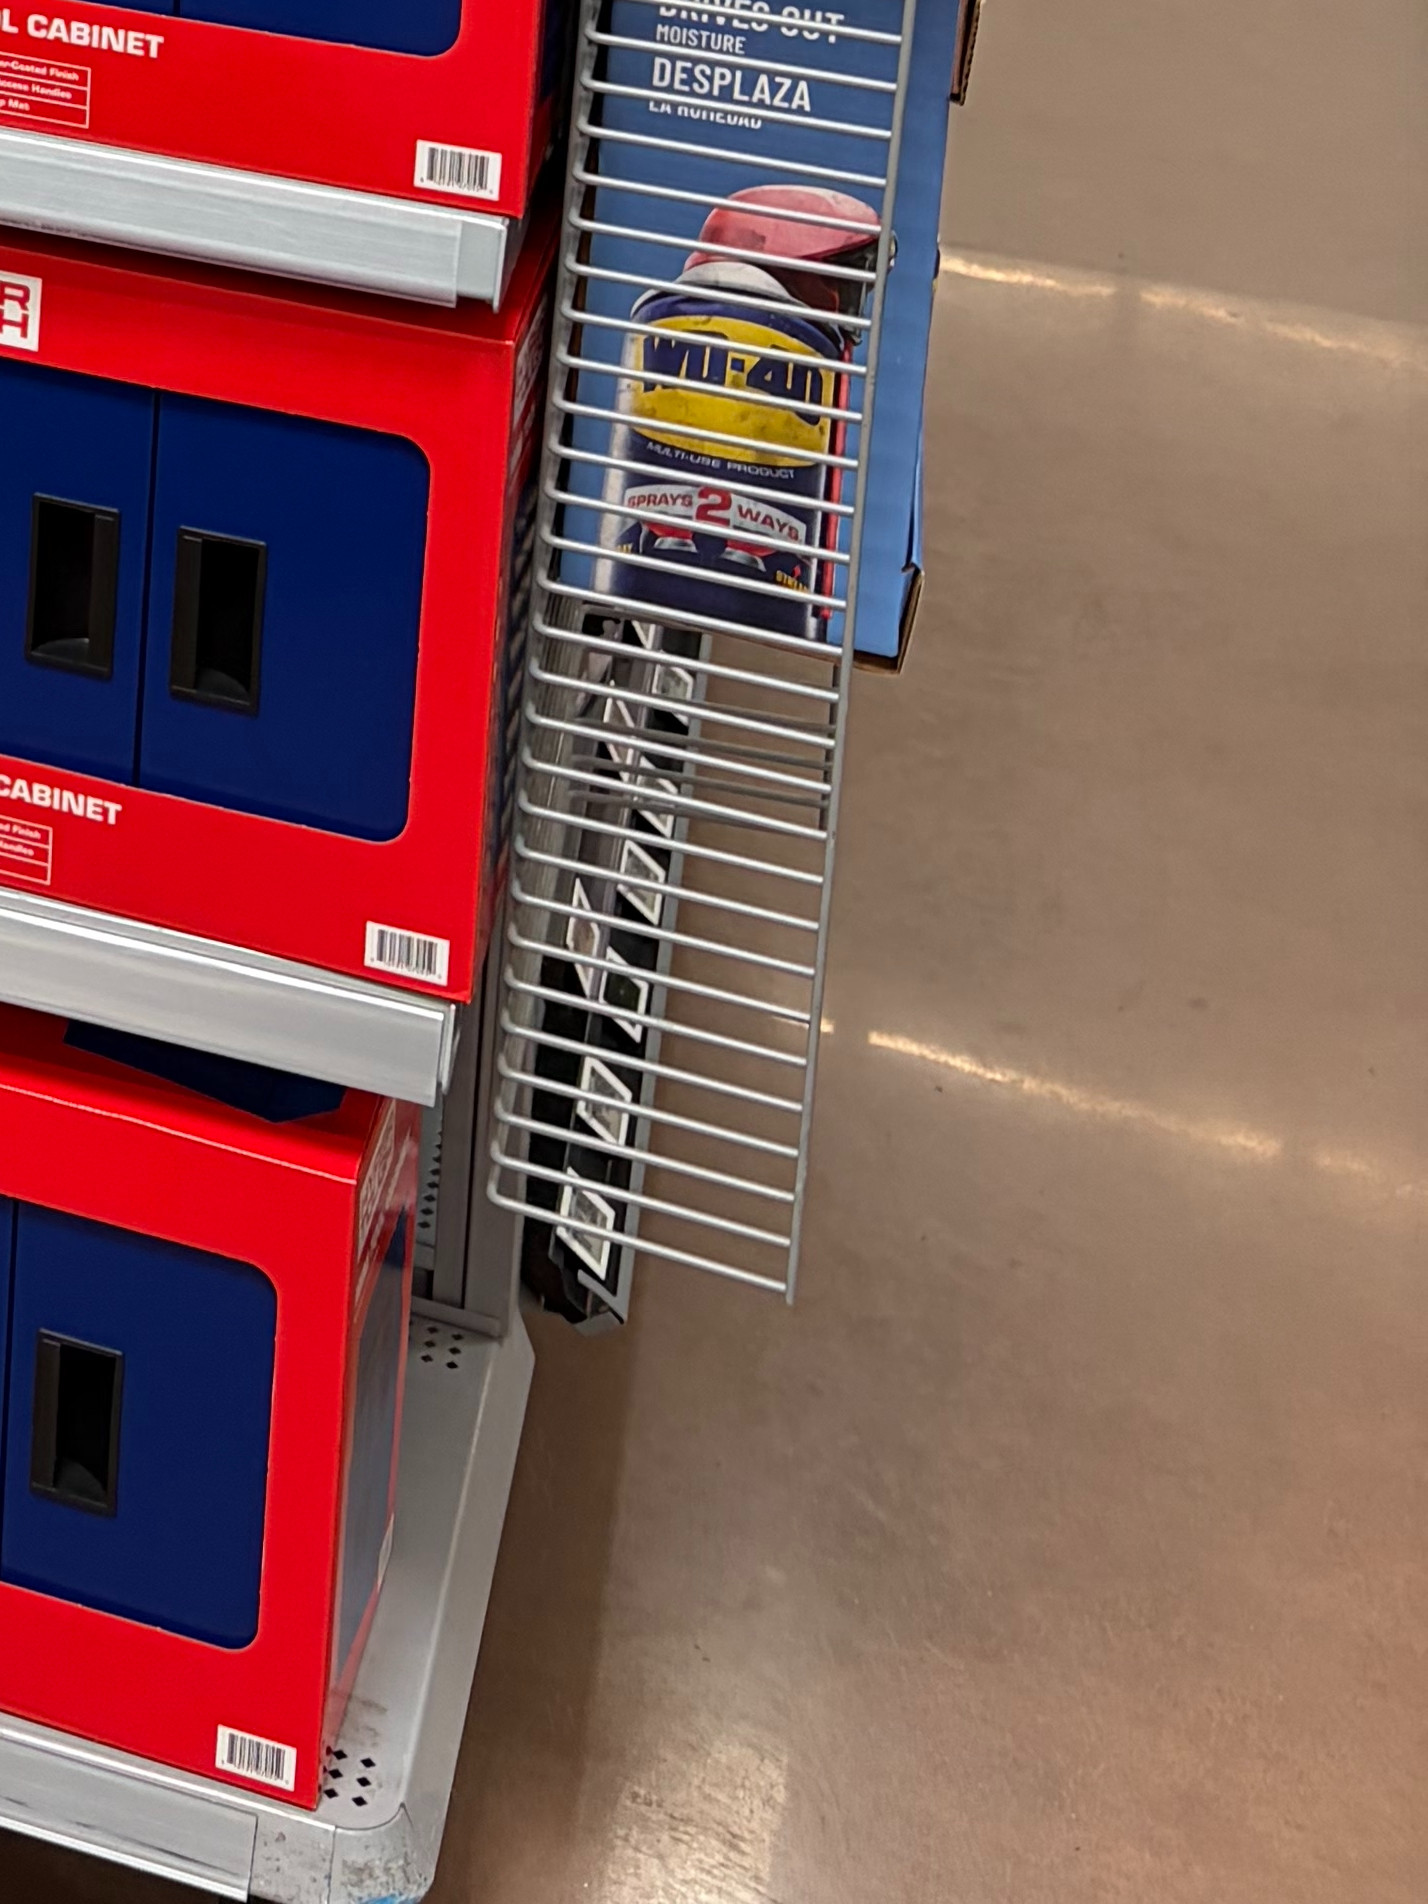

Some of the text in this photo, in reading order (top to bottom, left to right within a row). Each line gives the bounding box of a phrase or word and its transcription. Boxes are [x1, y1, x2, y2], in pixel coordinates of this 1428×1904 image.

[27, 14, 164, 59] CABINET
[655, 23, 747, 55] MOISTURE
[31, 82, 72, 100] Handles
[49, 67, 79, 82] Finish
[651, 56, 812, 113] DESPLAZA
[8, 97, 30, 112] Mat
[646, 441, 795, 480] MULTI-USE PRODUCT
[627, 485, 800, 544] SPRAYS 2 WAYS
